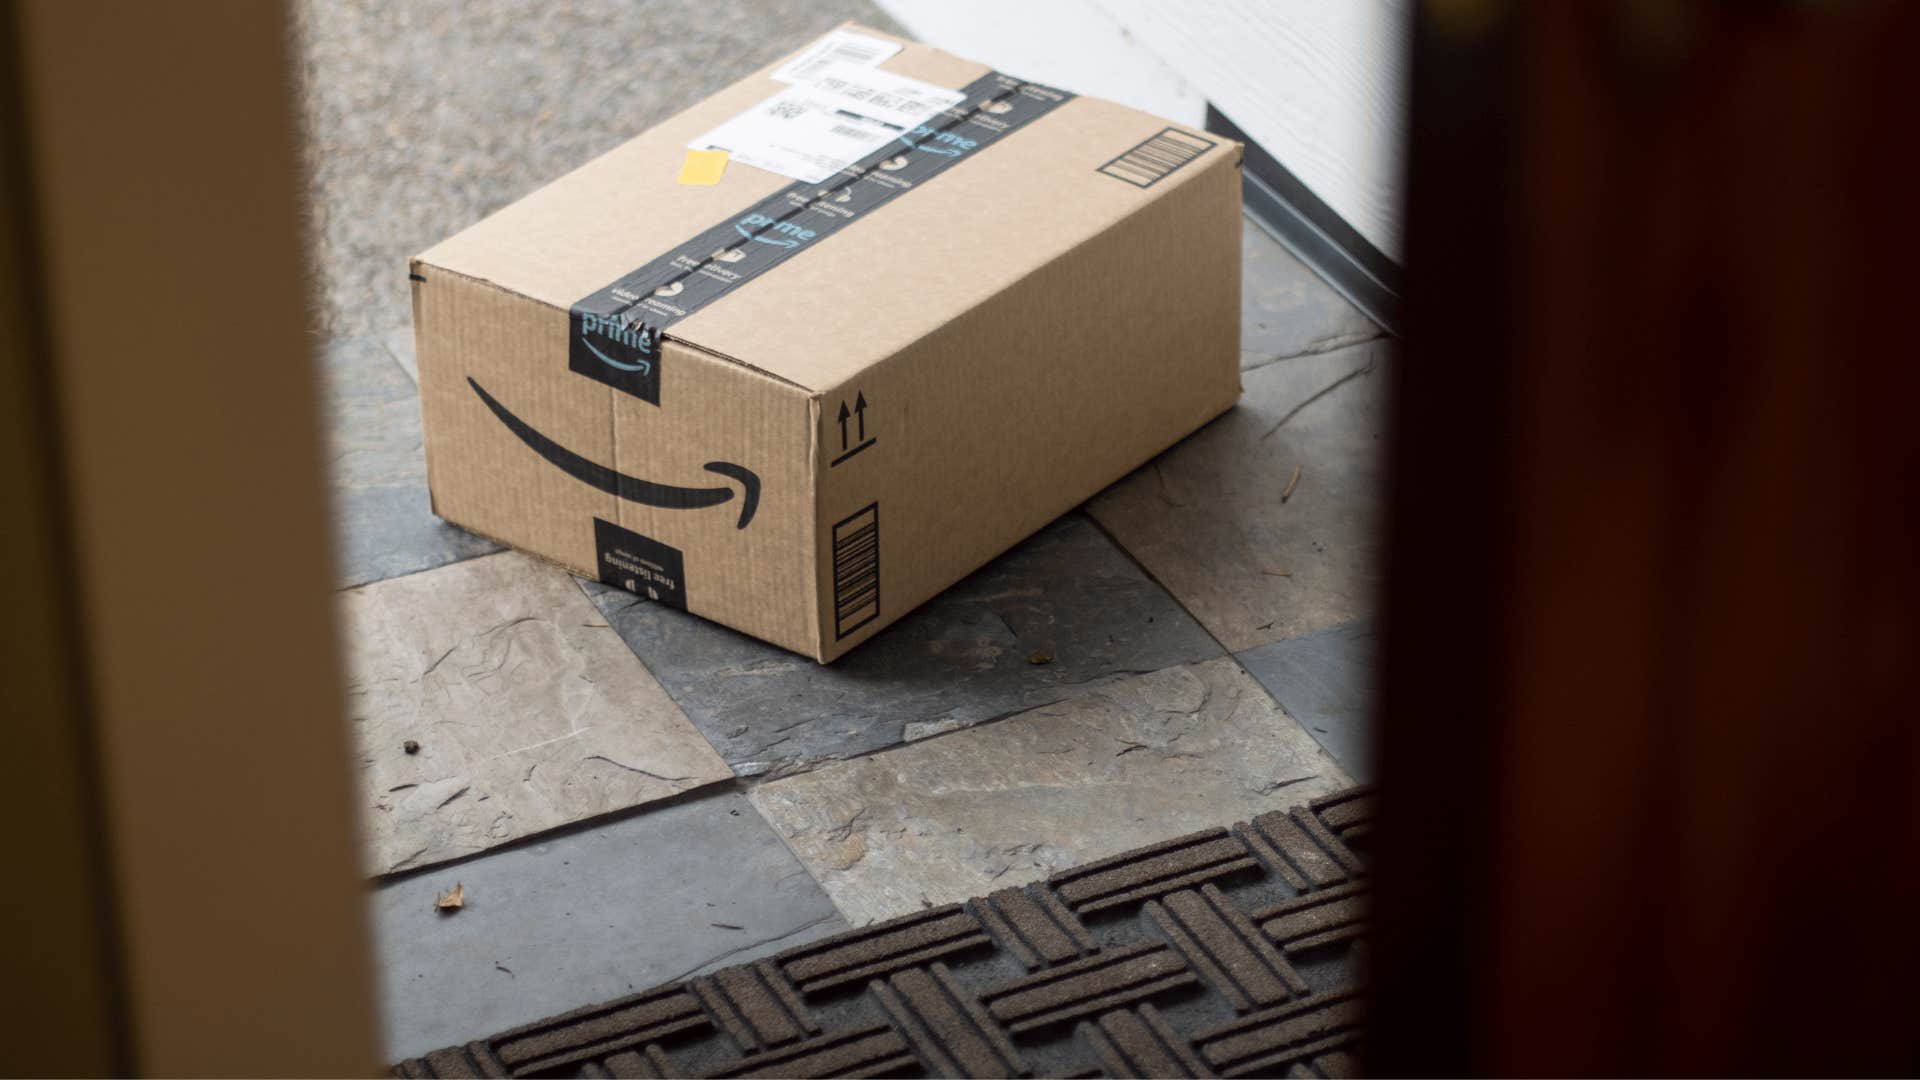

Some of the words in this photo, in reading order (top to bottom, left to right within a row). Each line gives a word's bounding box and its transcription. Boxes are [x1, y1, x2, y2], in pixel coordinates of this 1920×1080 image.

[912, 126, 978, 149] prme
[739, 213, 817, 241] prme
[677, 255, 701, 268] free
[703, 263, 743, 281] elivery
[611, 287, 640, 301] video
[643, 297, 687, 317] reaming
[582, 312, 652, 354] prime
[603, 552, 652, 581] listening
[653, 574, 675, 591] free
